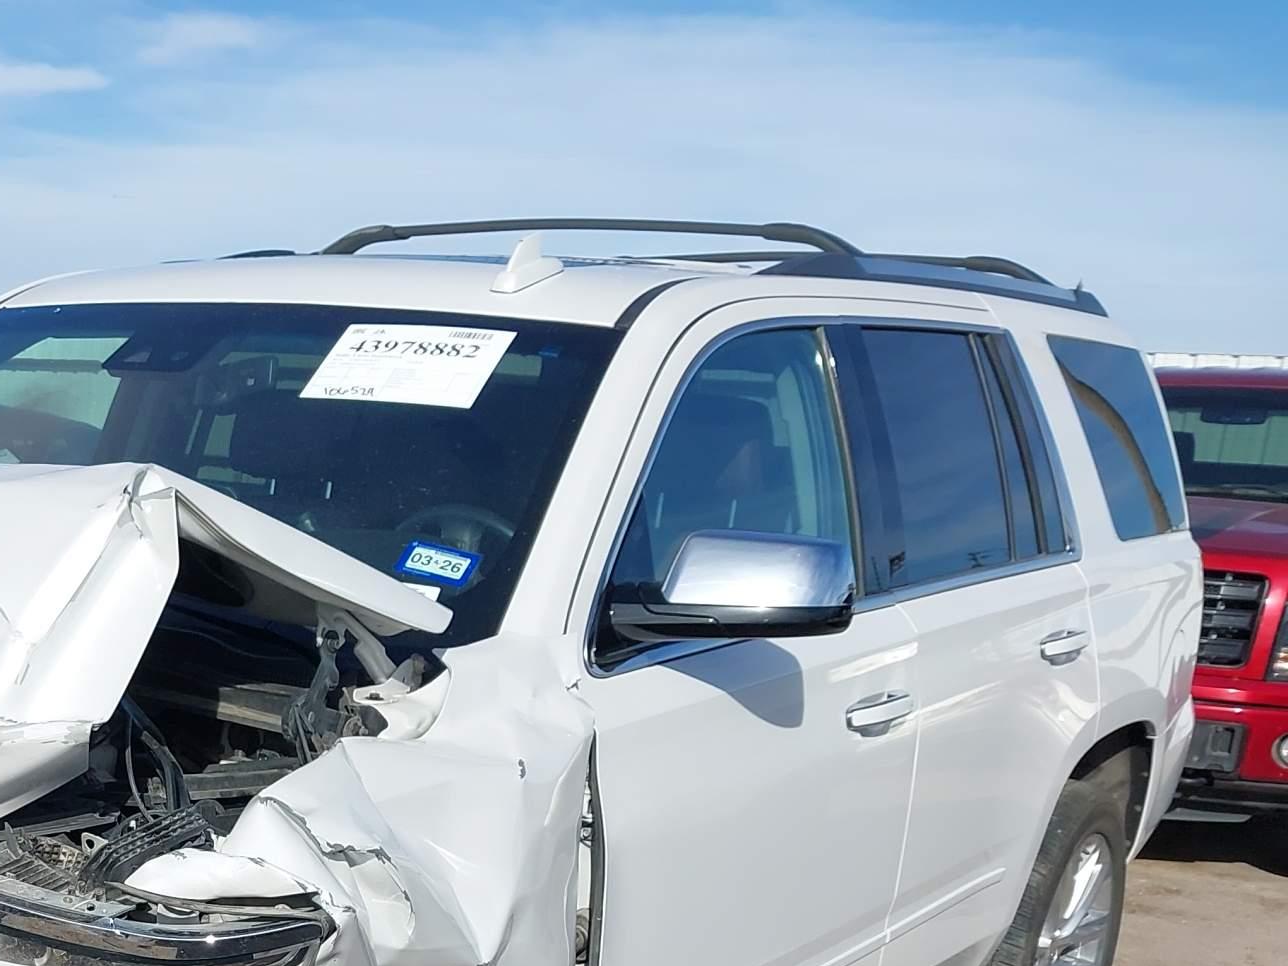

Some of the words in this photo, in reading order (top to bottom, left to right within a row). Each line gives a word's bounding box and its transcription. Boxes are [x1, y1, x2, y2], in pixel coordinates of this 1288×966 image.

[349, 339, 481, 359] 43978882
[411, 552, 433, 566] 03
[439, 559, 463, 574] 26
